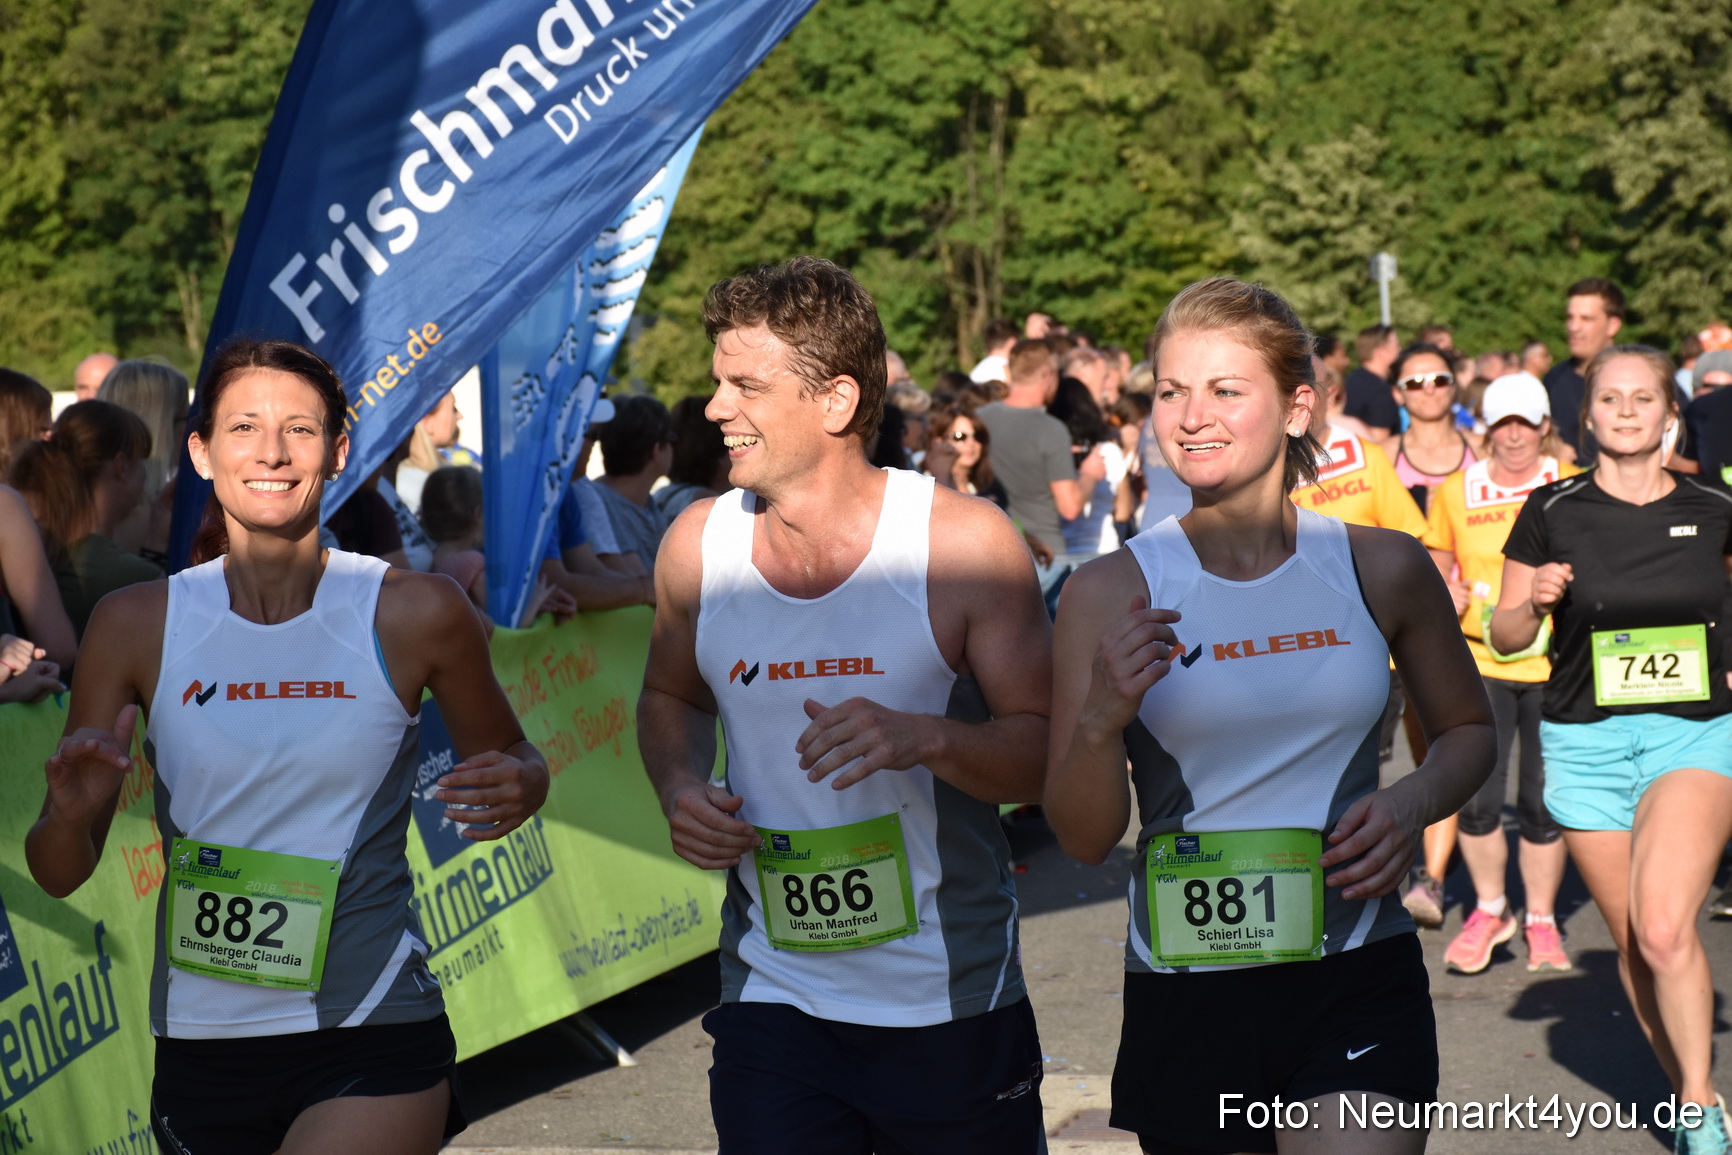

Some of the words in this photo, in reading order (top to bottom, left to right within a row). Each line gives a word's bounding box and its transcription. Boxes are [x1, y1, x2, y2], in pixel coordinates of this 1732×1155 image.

[544, 36, 649, 145] Druck
[1311, 478, 1372, 507] BÖGL
[1466, 510, 1507, 528] MAX
[1212, 628, 1351, 662] KLEBL
[767, 656, 885, 681] KLEBL
[1619, 653, 1680, 681] 742
[226, 681, 357, 700] KLEBL
[767, 848, 811, 860] firmenlauf
[820, 855, 850, 867] 2018
[1166, 850, 1223, 864] firmenlauf
[188, 861, 242, 879] firmenlauf
[1231, 859, 1263, 870] 2018
[245, 881, 277, 894] 2018
[782, 868, 874, 917] 866
[1184, 875, 1275, 926] 881
[195, 891, 289, 949] 882
[789, 919, 823, 931] Urban
[826, 912, 878, 929] Manfred
[808, 932, 829, 940] Klebl
[831, 928, 858, 939] GmbH
[1197, 927, 1242, 941] Schierl
[1246, 927, 1274, 939] Lisa
[179, 936, 249, 960] Ehrnsberger
[251, 949, 302, 966] Claudia
[1209, 943, 1231, 951] Klebl
[1234, 941, 1262, 950] GmbH
[209, 956, 230, 967] Klebl
[231, 960, 257, 971] GmbH
[0, 920, 119, 1100] enlauf
